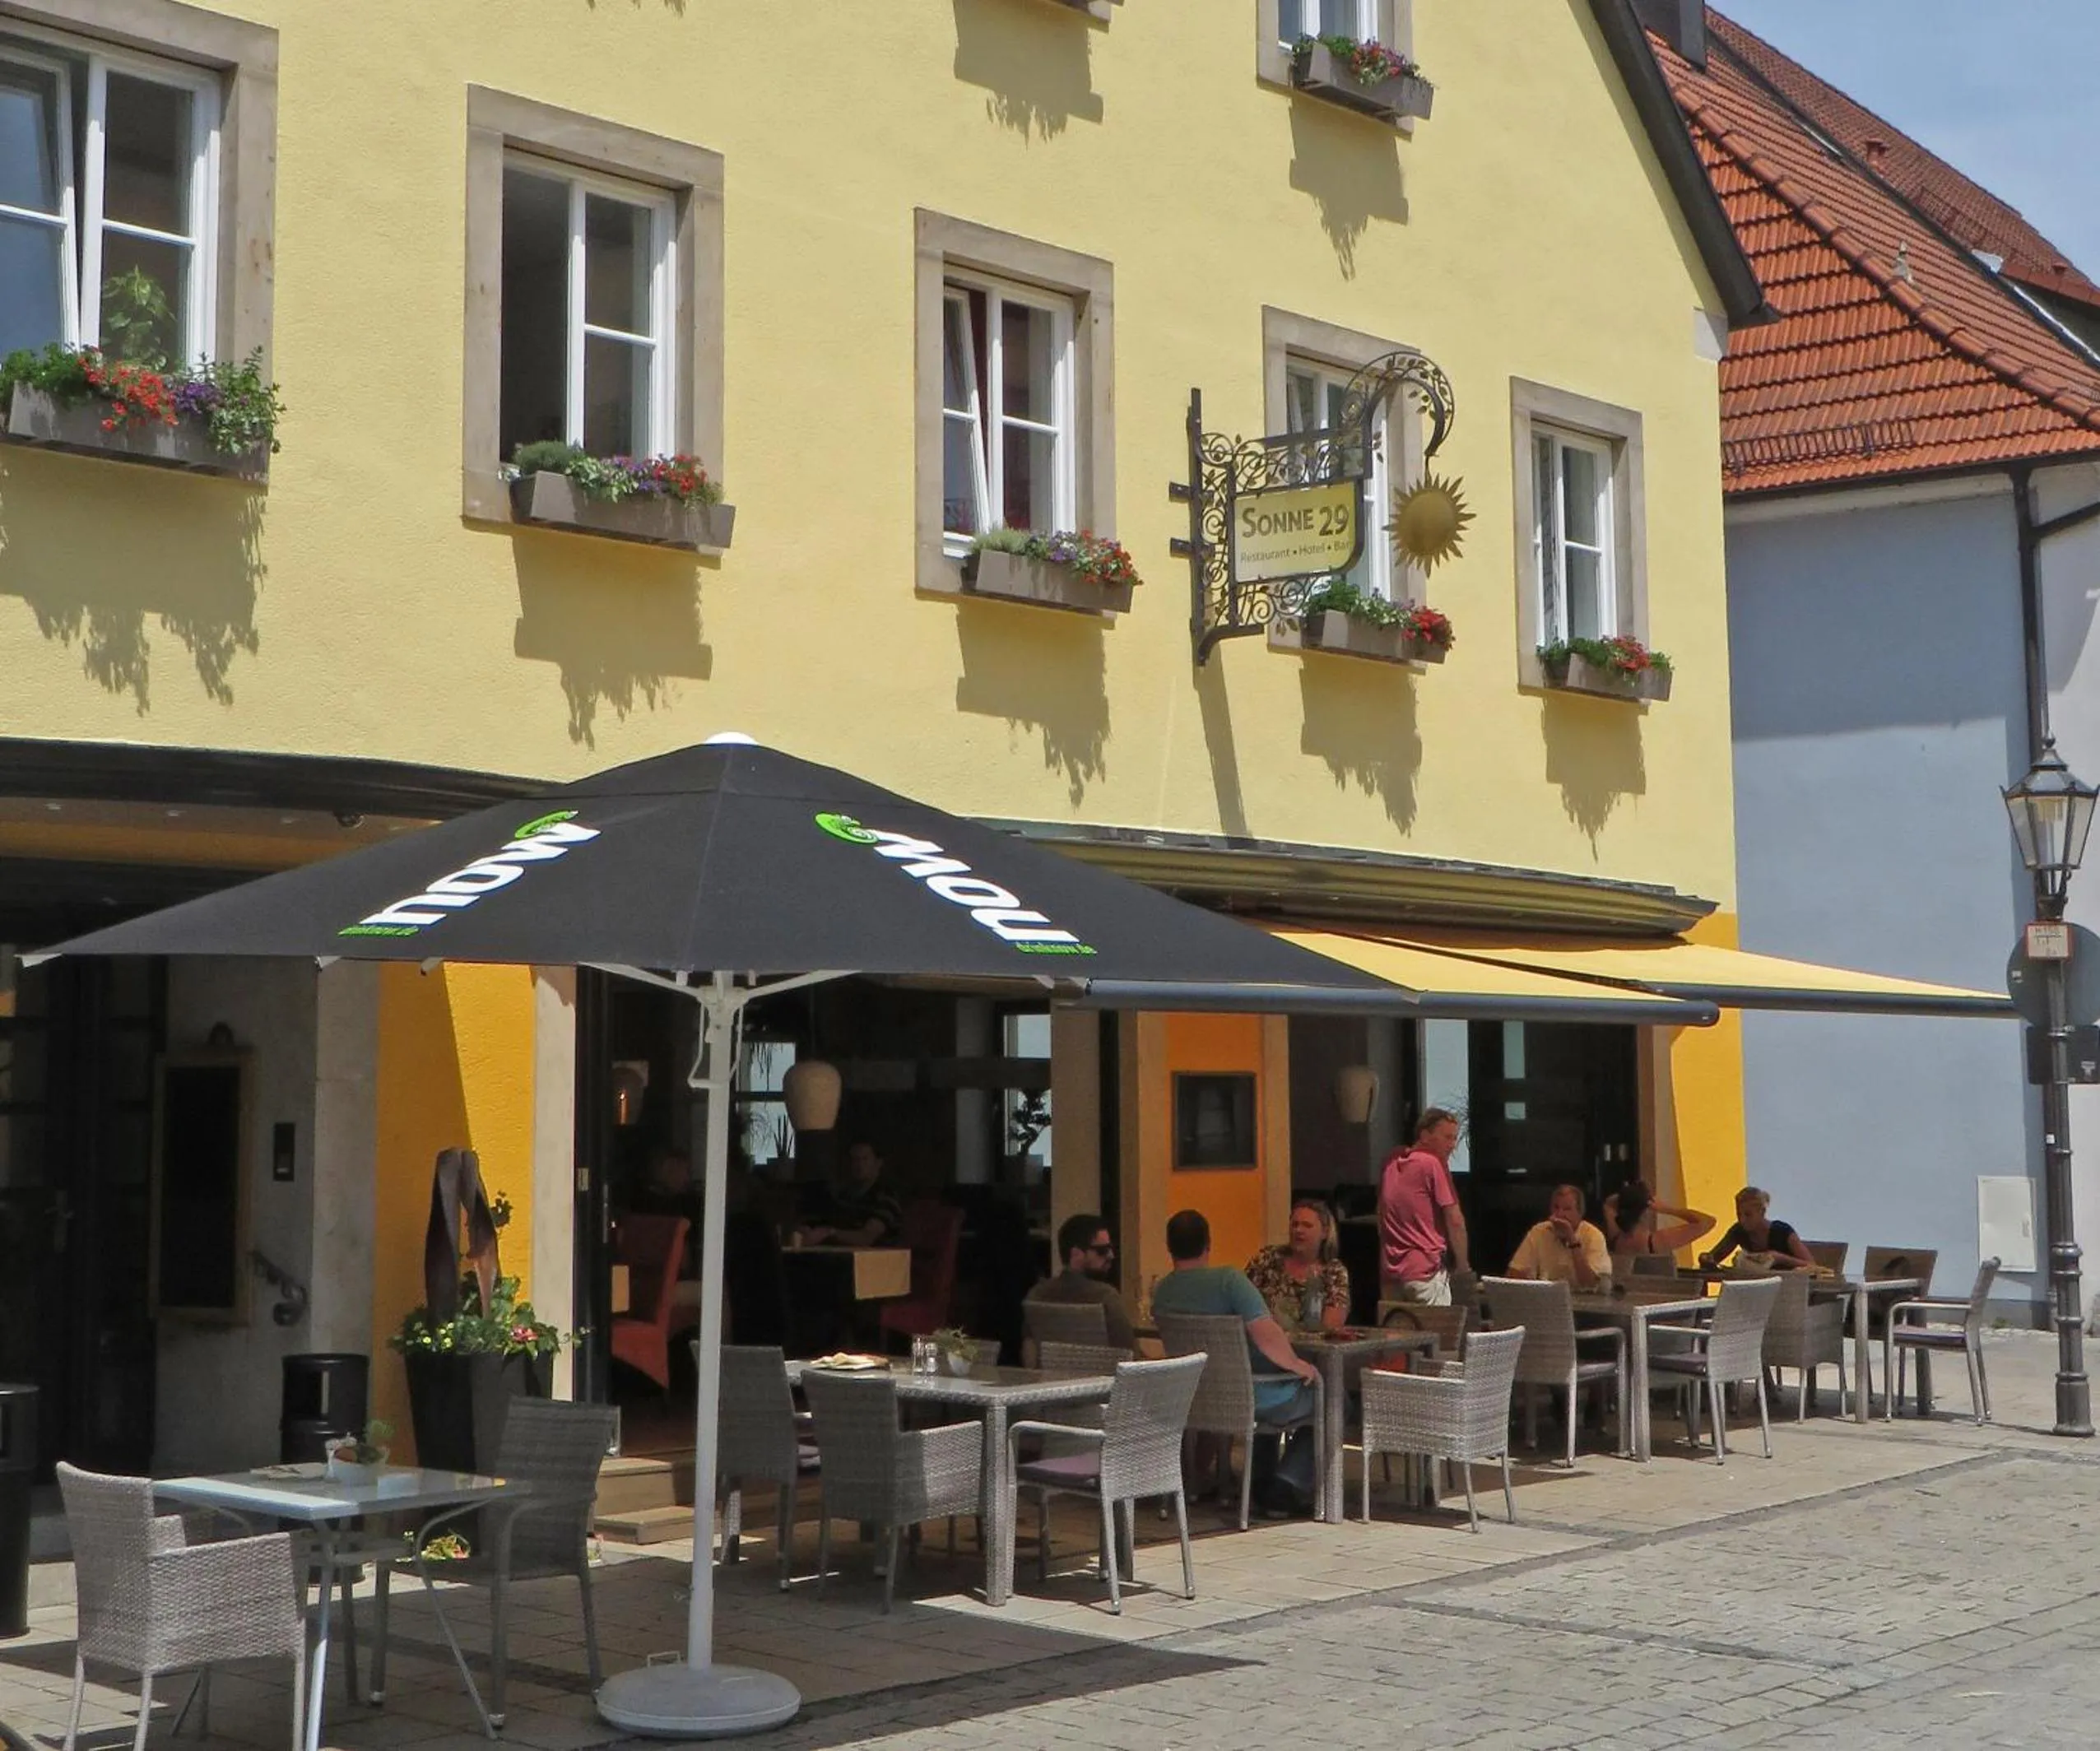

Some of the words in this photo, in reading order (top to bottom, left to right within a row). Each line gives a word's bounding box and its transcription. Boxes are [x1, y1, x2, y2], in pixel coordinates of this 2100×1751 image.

[1242, 507, 1314, 537] SONNE
[1319, 504, 1350, 536] 29
[1240, 549, 1289, 563] Restaurant
[1299, 543, 1325, 556] Hotel
